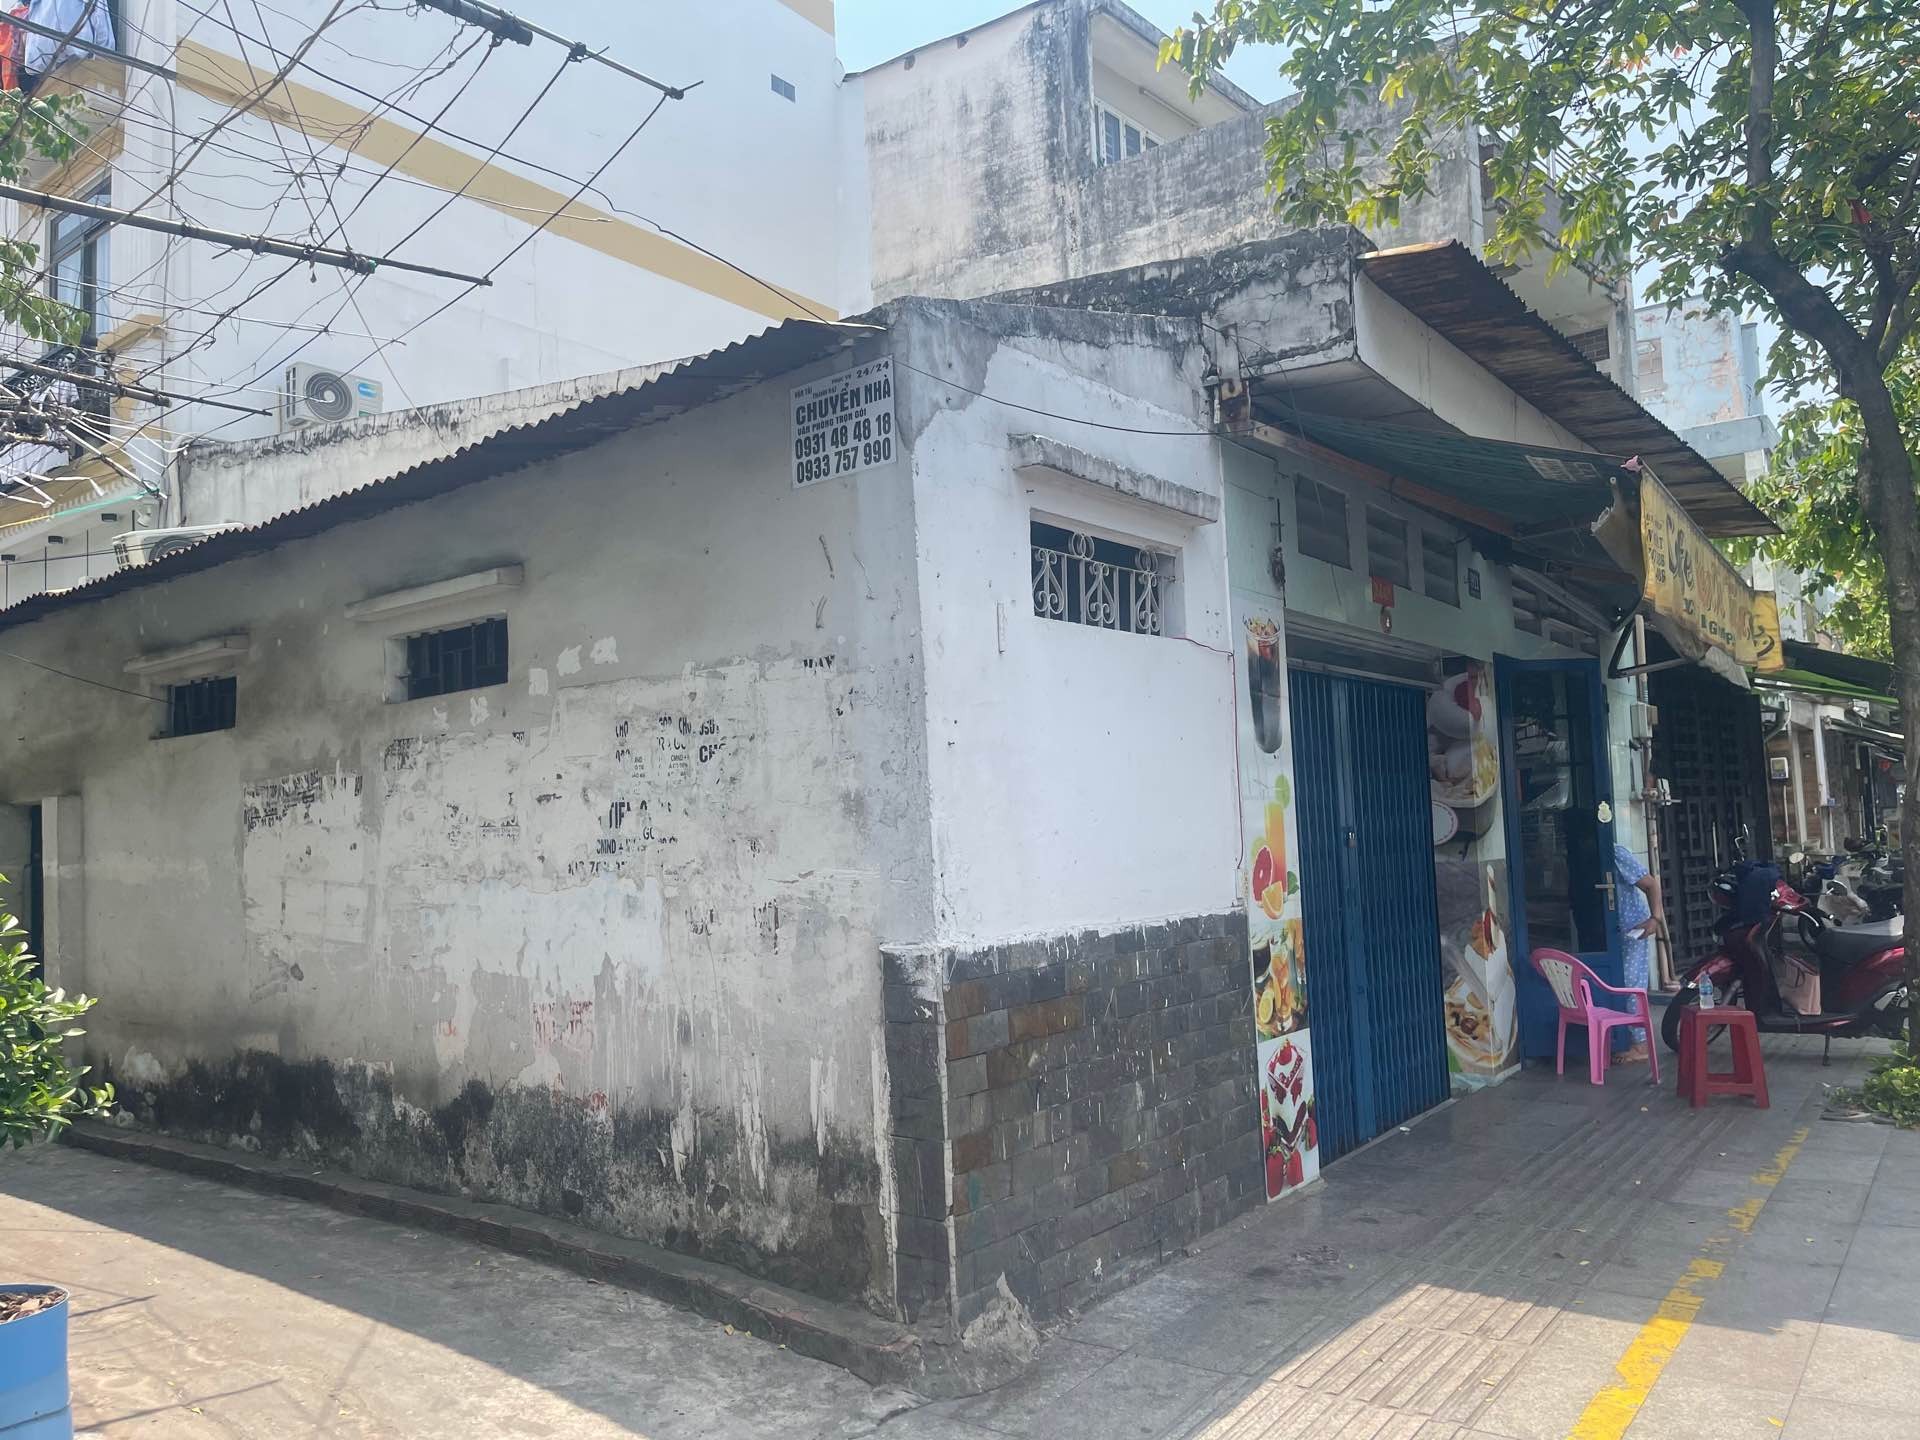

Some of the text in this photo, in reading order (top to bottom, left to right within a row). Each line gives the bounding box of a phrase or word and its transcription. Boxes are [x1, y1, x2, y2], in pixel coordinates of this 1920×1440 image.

[856, 361, 889, 379] 24/24
[796, 374, 891, 425] CHUYỂN NHÀ
[795, 412, 892, 460] 0931 48 48 18
[797, 437, 891, 483] 0933 757 990
